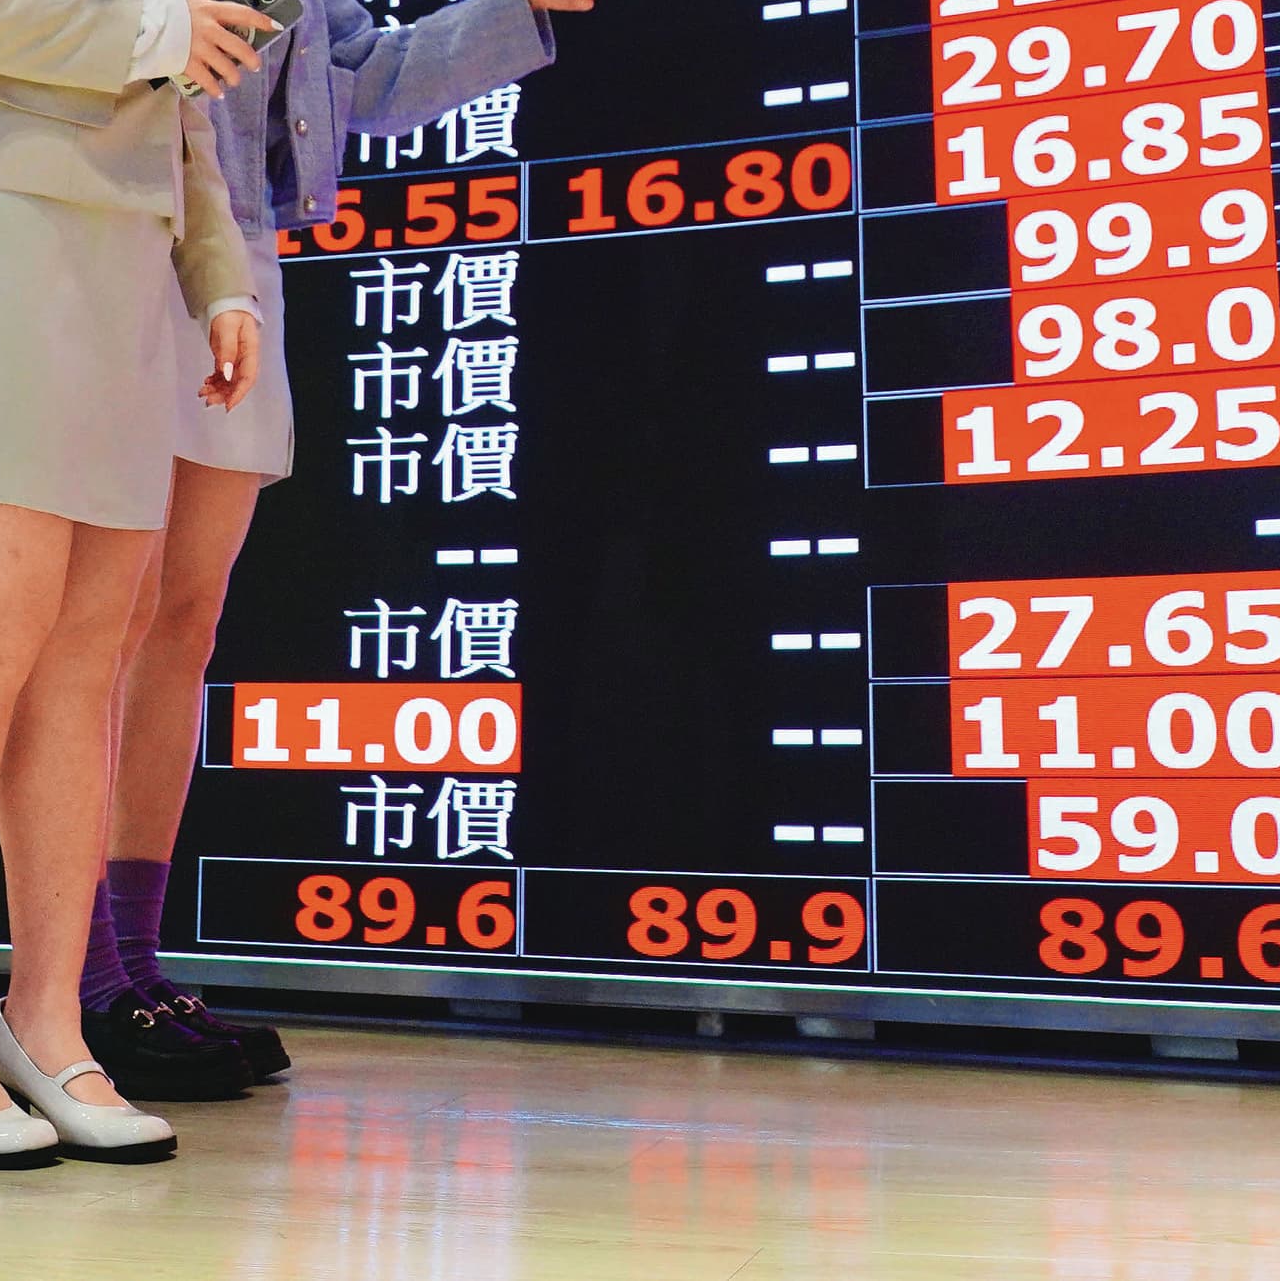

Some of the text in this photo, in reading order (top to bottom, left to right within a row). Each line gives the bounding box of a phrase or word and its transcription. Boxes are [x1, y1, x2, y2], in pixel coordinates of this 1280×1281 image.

[943, 0, 1257, 105] 29.70
[948, 92, 1262, 196] 16.85
[569, 143, 851, 232] 16.80
[1015, 190, 1267, 282] 99.9
[350, 251, 519, 333] 市價
[1019, 287, 1275, 377] 98.0
[348, 336, 519, 418] 市價
[347, 422, 519, 503] 市價
[957, 386, 1280, 475] 12.25
[244, 698, 516, 764] 11.00
[296, 875, 515, 949] 89.6
[628, 887, 865, 964] 89.9
